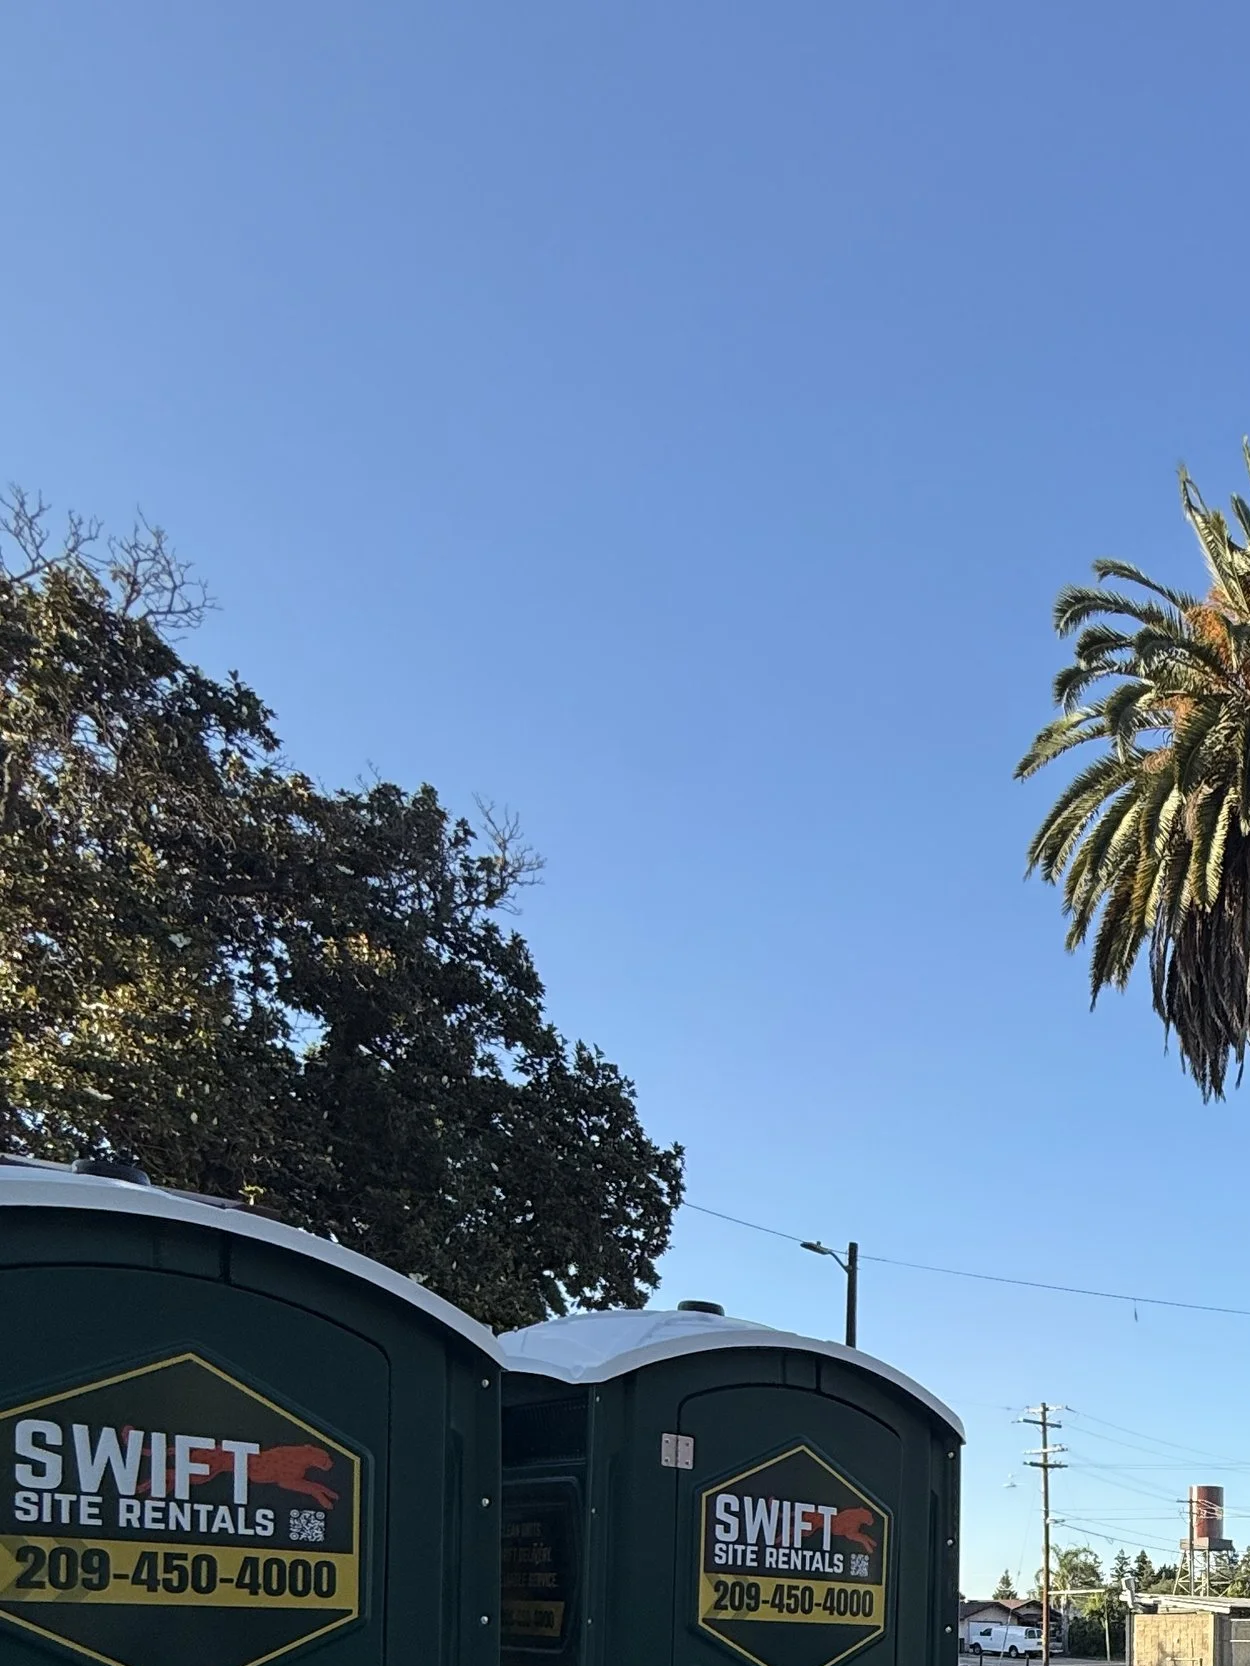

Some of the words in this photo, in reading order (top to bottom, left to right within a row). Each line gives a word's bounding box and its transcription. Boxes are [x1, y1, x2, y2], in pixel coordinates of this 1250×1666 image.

[15, 1419, 260, 1505] SWIFT
[14, 1491, 103, 1526] SITE
[118, 1499, 275, 1537] RENTALS
[715, 1493, 837, 1551] SWIFT
[15, 1546, 337, 1598] 209-450-4000
[714, 1543, 758, 1567] SITE
[765, 1547, 844, 1573] RENTALS
[713, 1580, 874, 1617] 209-450-4000
